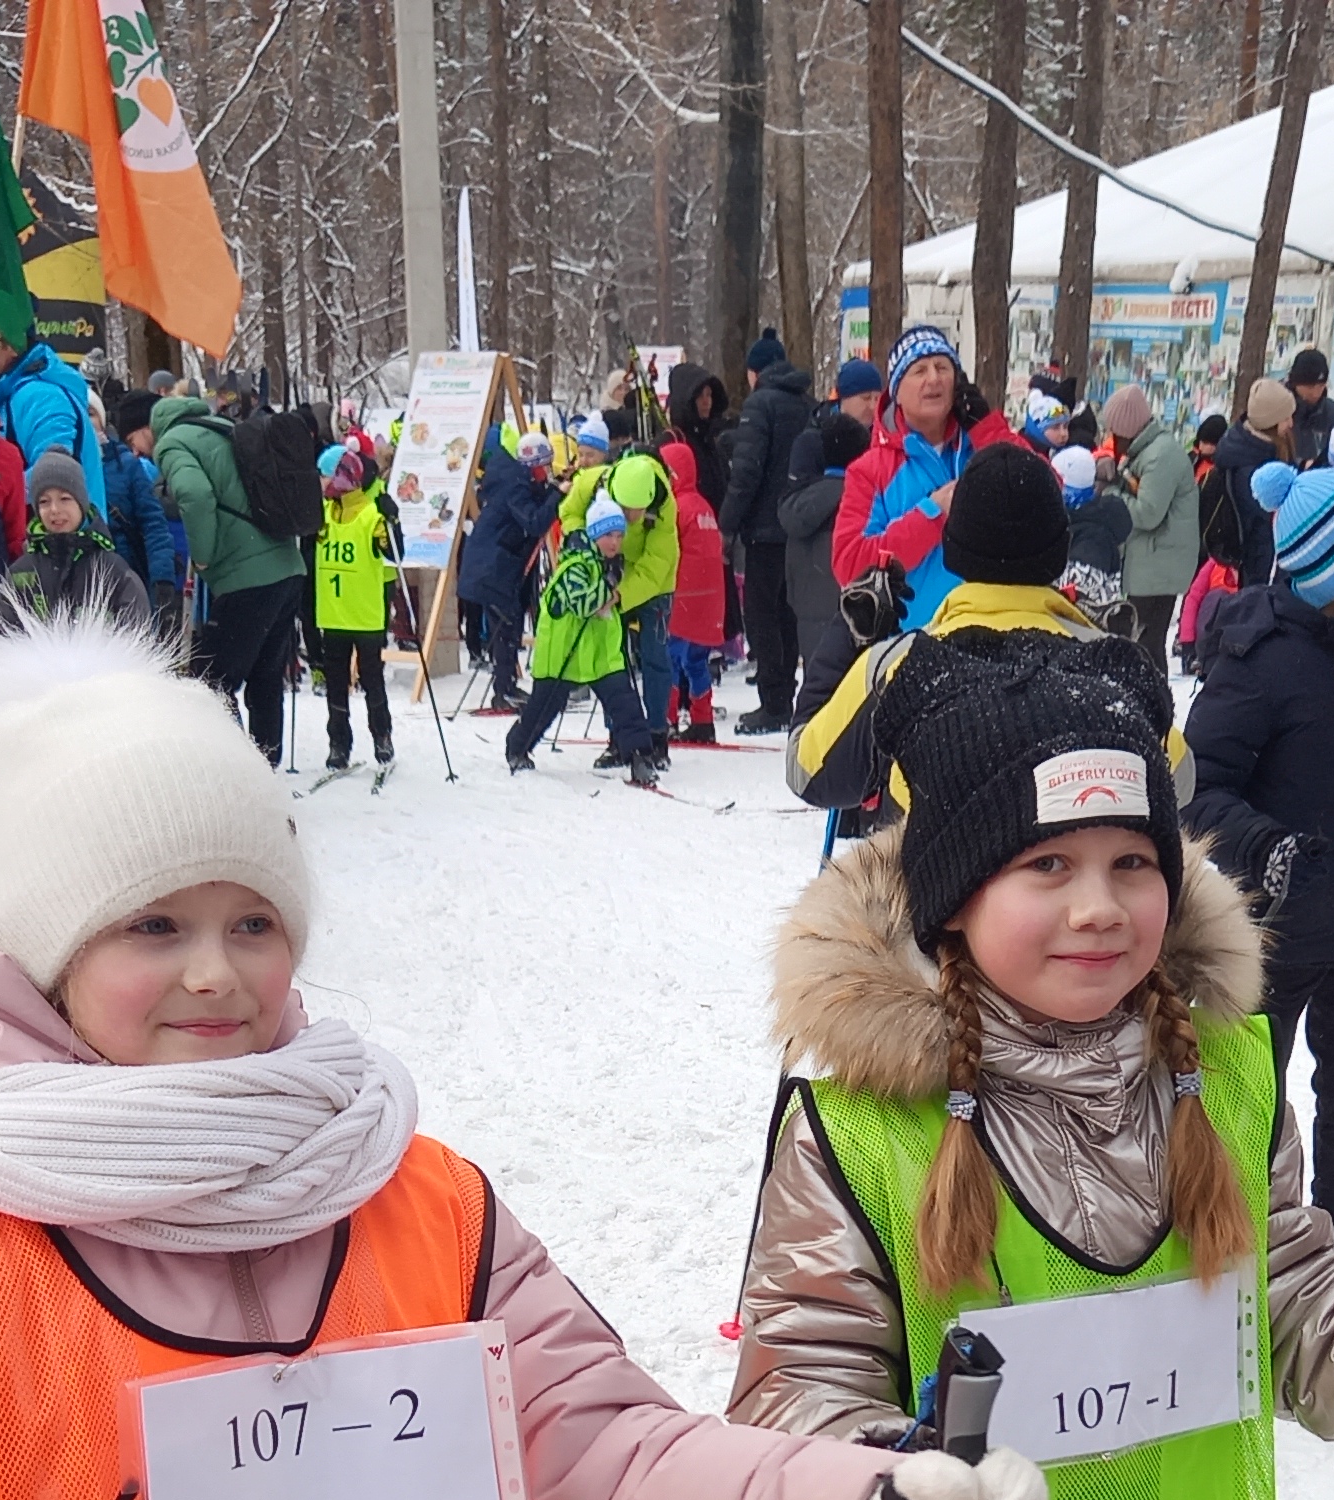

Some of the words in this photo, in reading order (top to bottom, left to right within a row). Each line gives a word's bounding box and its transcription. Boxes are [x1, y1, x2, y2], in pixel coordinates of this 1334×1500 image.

[322, 541, 355, 564] 118
[329, 573, 341, 598] 1
[1049, 767, 1107, 789] BITTERLY
[1109, 767, 1139, 781] LOVE
[1052, 1381, 1131, 1435] 107
[1146, 1368, 1179, 1411] -1
[226, 1401, 308, 1471] 107
[389, 1388, 425, 1442] 2
